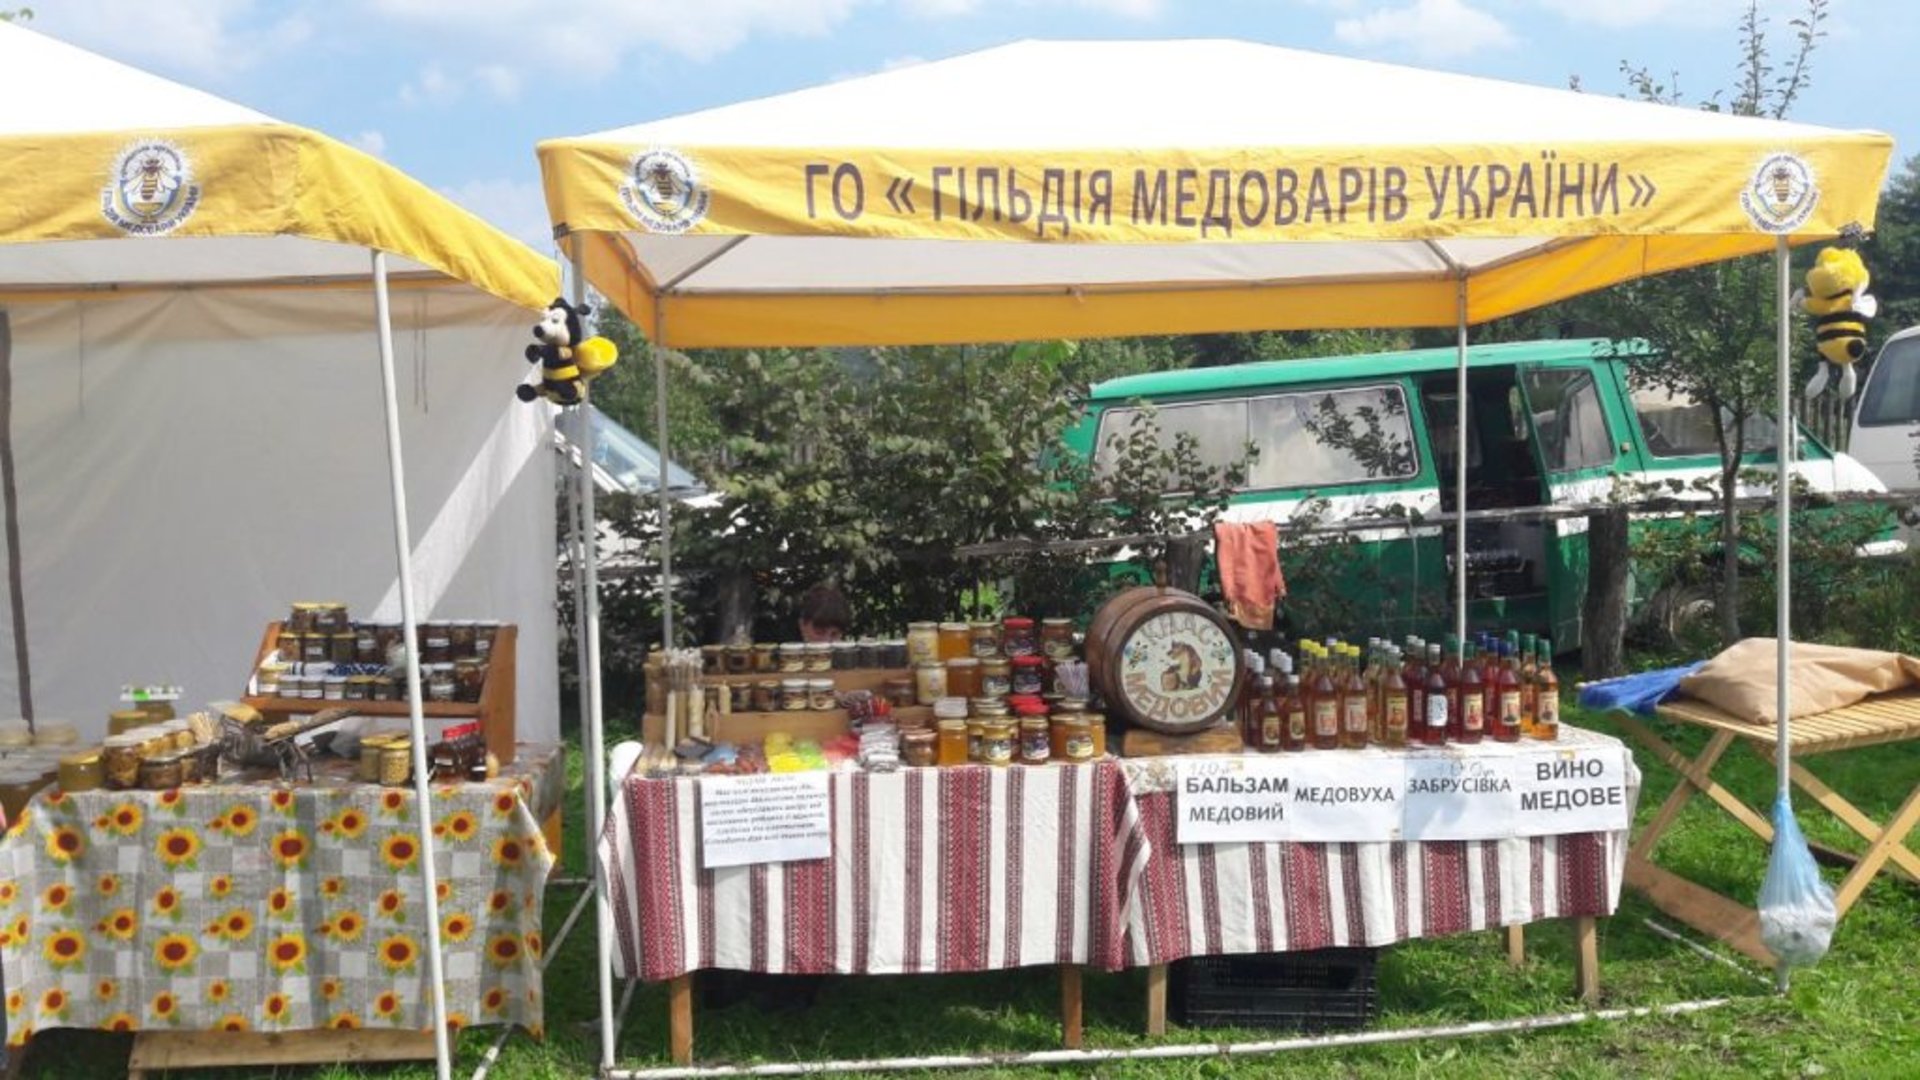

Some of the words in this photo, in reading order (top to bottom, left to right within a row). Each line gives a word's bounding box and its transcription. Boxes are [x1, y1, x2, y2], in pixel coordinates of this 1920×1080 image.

[804, 162, 865, 220] ГО
[932, 166, 1112, 237] ГІЛЬДІЯ
[1131, 166, 1409, 238] МЕДОВАРІВ
[1536, 759, 1604, 781] ВИНО
[1186, 777, 1290, 794] БАЛЬЗАМ
[1294, 786, 1396, 805] МЕДОВУХА
[1407, 777, 1513, 794] ЗАБРУСІВКА
[1520, 786, 1623, 812] МЕДОВЕ
[1188, 803, 1285, 825] МЕДОВИЙ
